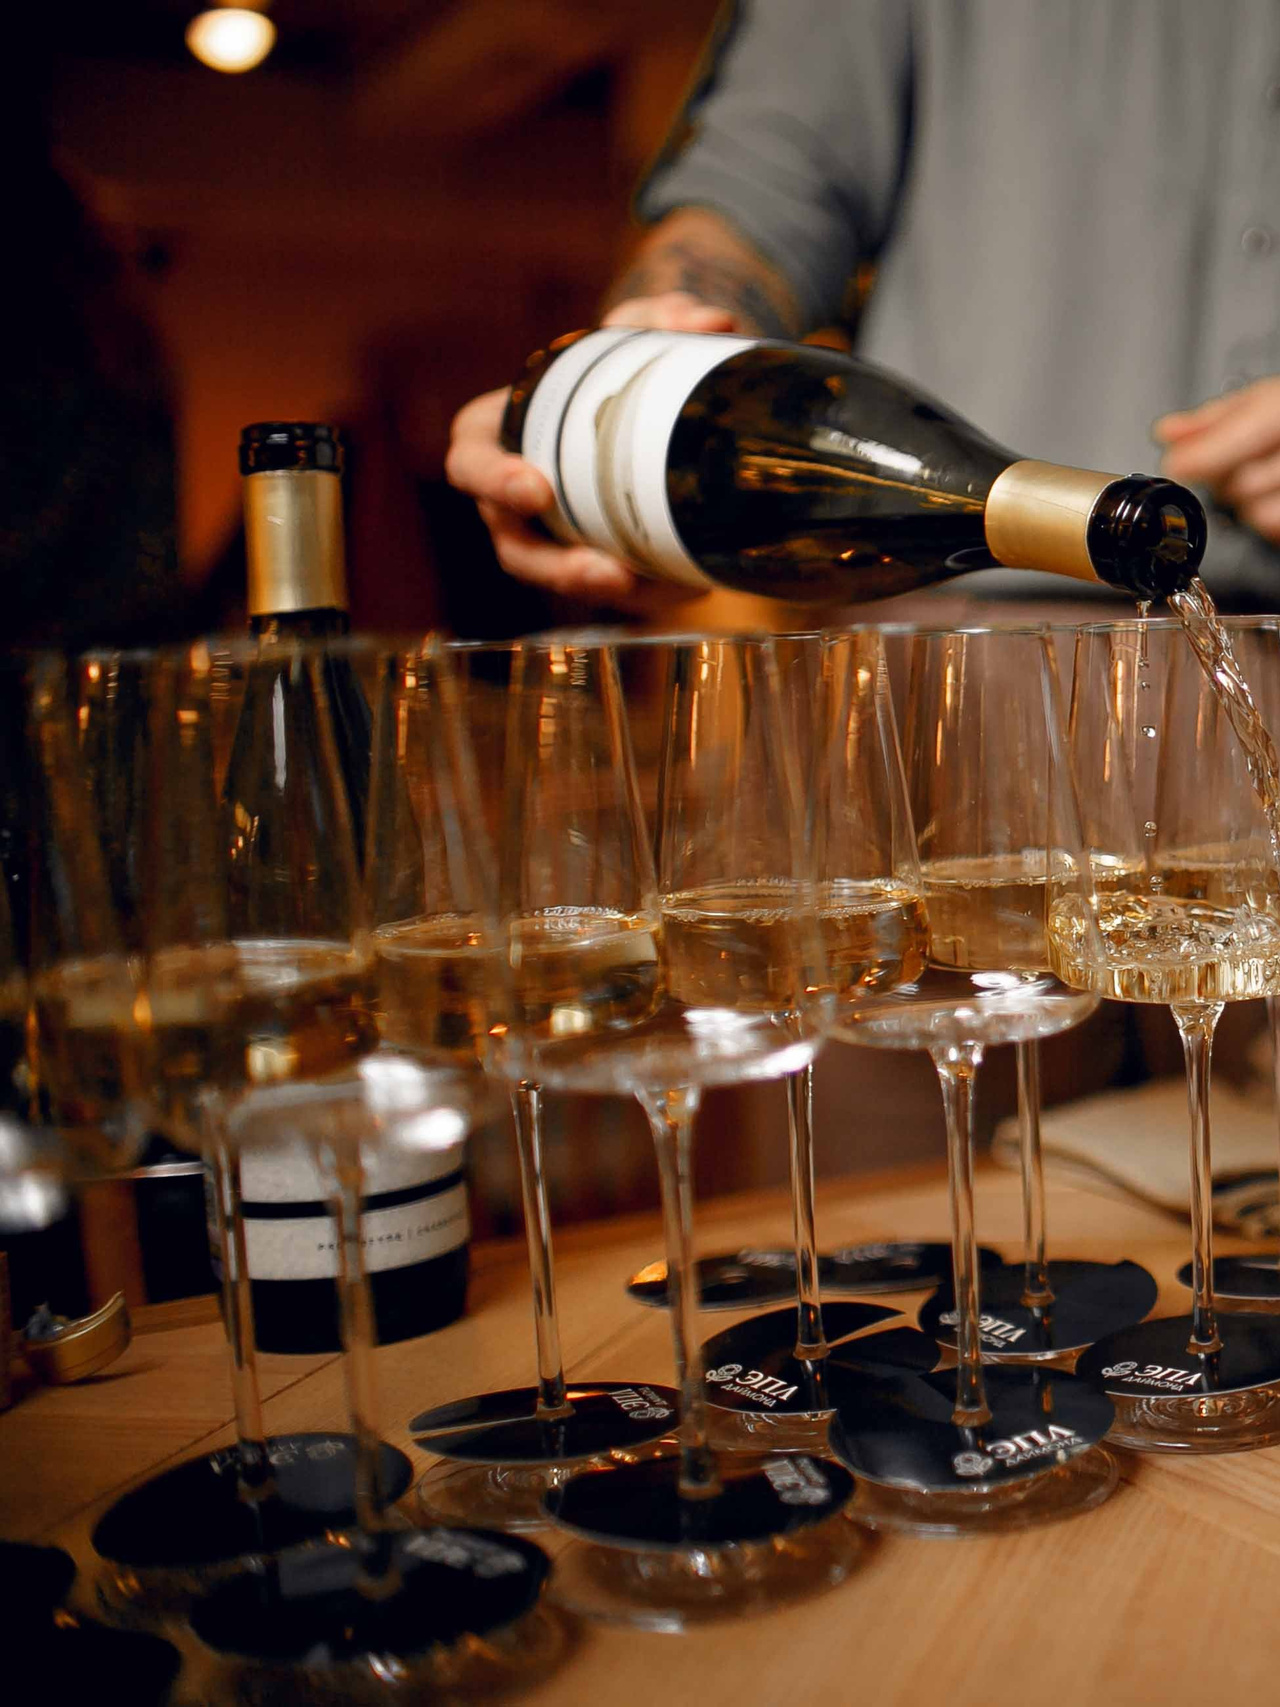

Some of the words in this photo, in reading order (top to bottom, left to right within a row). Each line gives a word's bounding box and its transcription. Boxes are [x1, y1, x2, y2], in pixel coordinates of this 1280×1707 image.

[735, 1370, 799, 1401] ЭПЛ
[1134, 1364, 1202, 1386] ЭПЛ
[985, 1424, 1076, 1459] ЭПЛ
